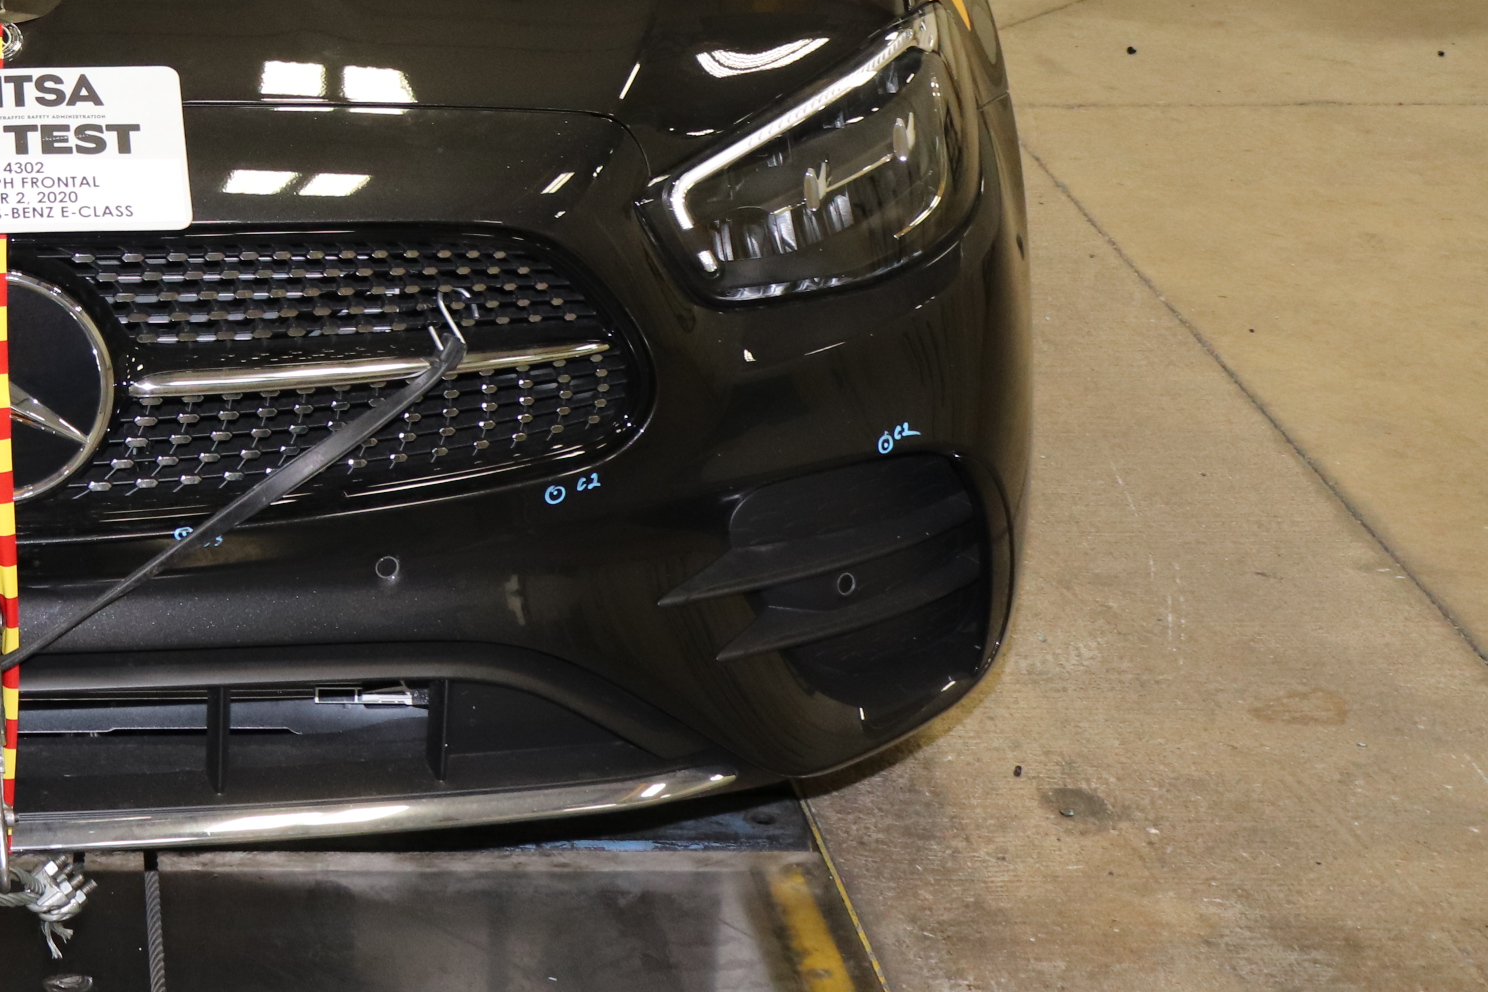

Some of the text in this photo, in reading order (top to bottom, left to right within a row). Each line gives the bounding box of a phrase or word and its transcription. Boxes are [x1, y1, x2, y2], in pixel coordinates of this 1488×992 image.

[2, 123, 141, 155] TEST
[21, 176, 100, 189] FRONTAL
[15, 192, 31, 207] 2,
[37, 191, 79, 204] 2020
[61, 205, 134, 219] E-CLASS
